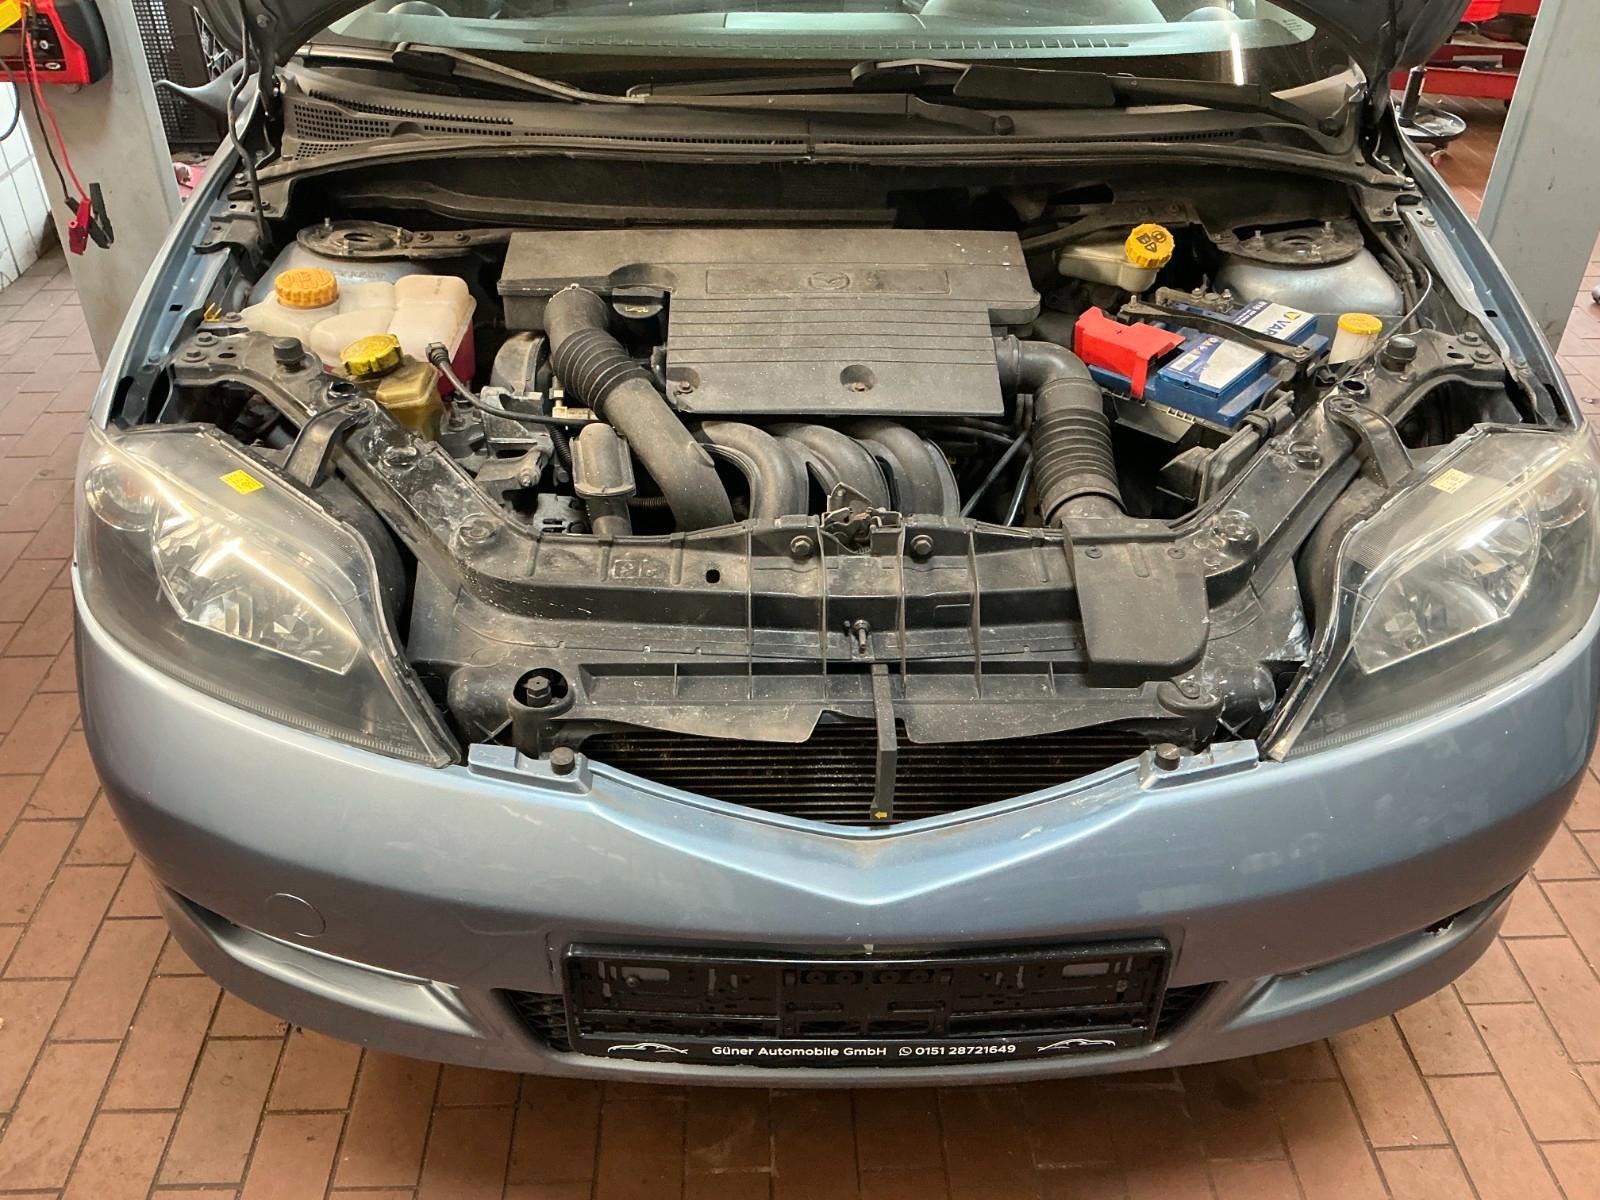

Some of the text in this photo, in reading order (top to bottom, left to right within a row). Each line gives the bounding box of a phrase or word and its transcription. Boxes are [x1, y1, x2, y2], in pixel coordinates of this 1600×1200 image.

[1266, 320, 1292, 336] VAR
[711, 1044, 1016, 1056] Güner Automobile GmbH 0151 28721649
